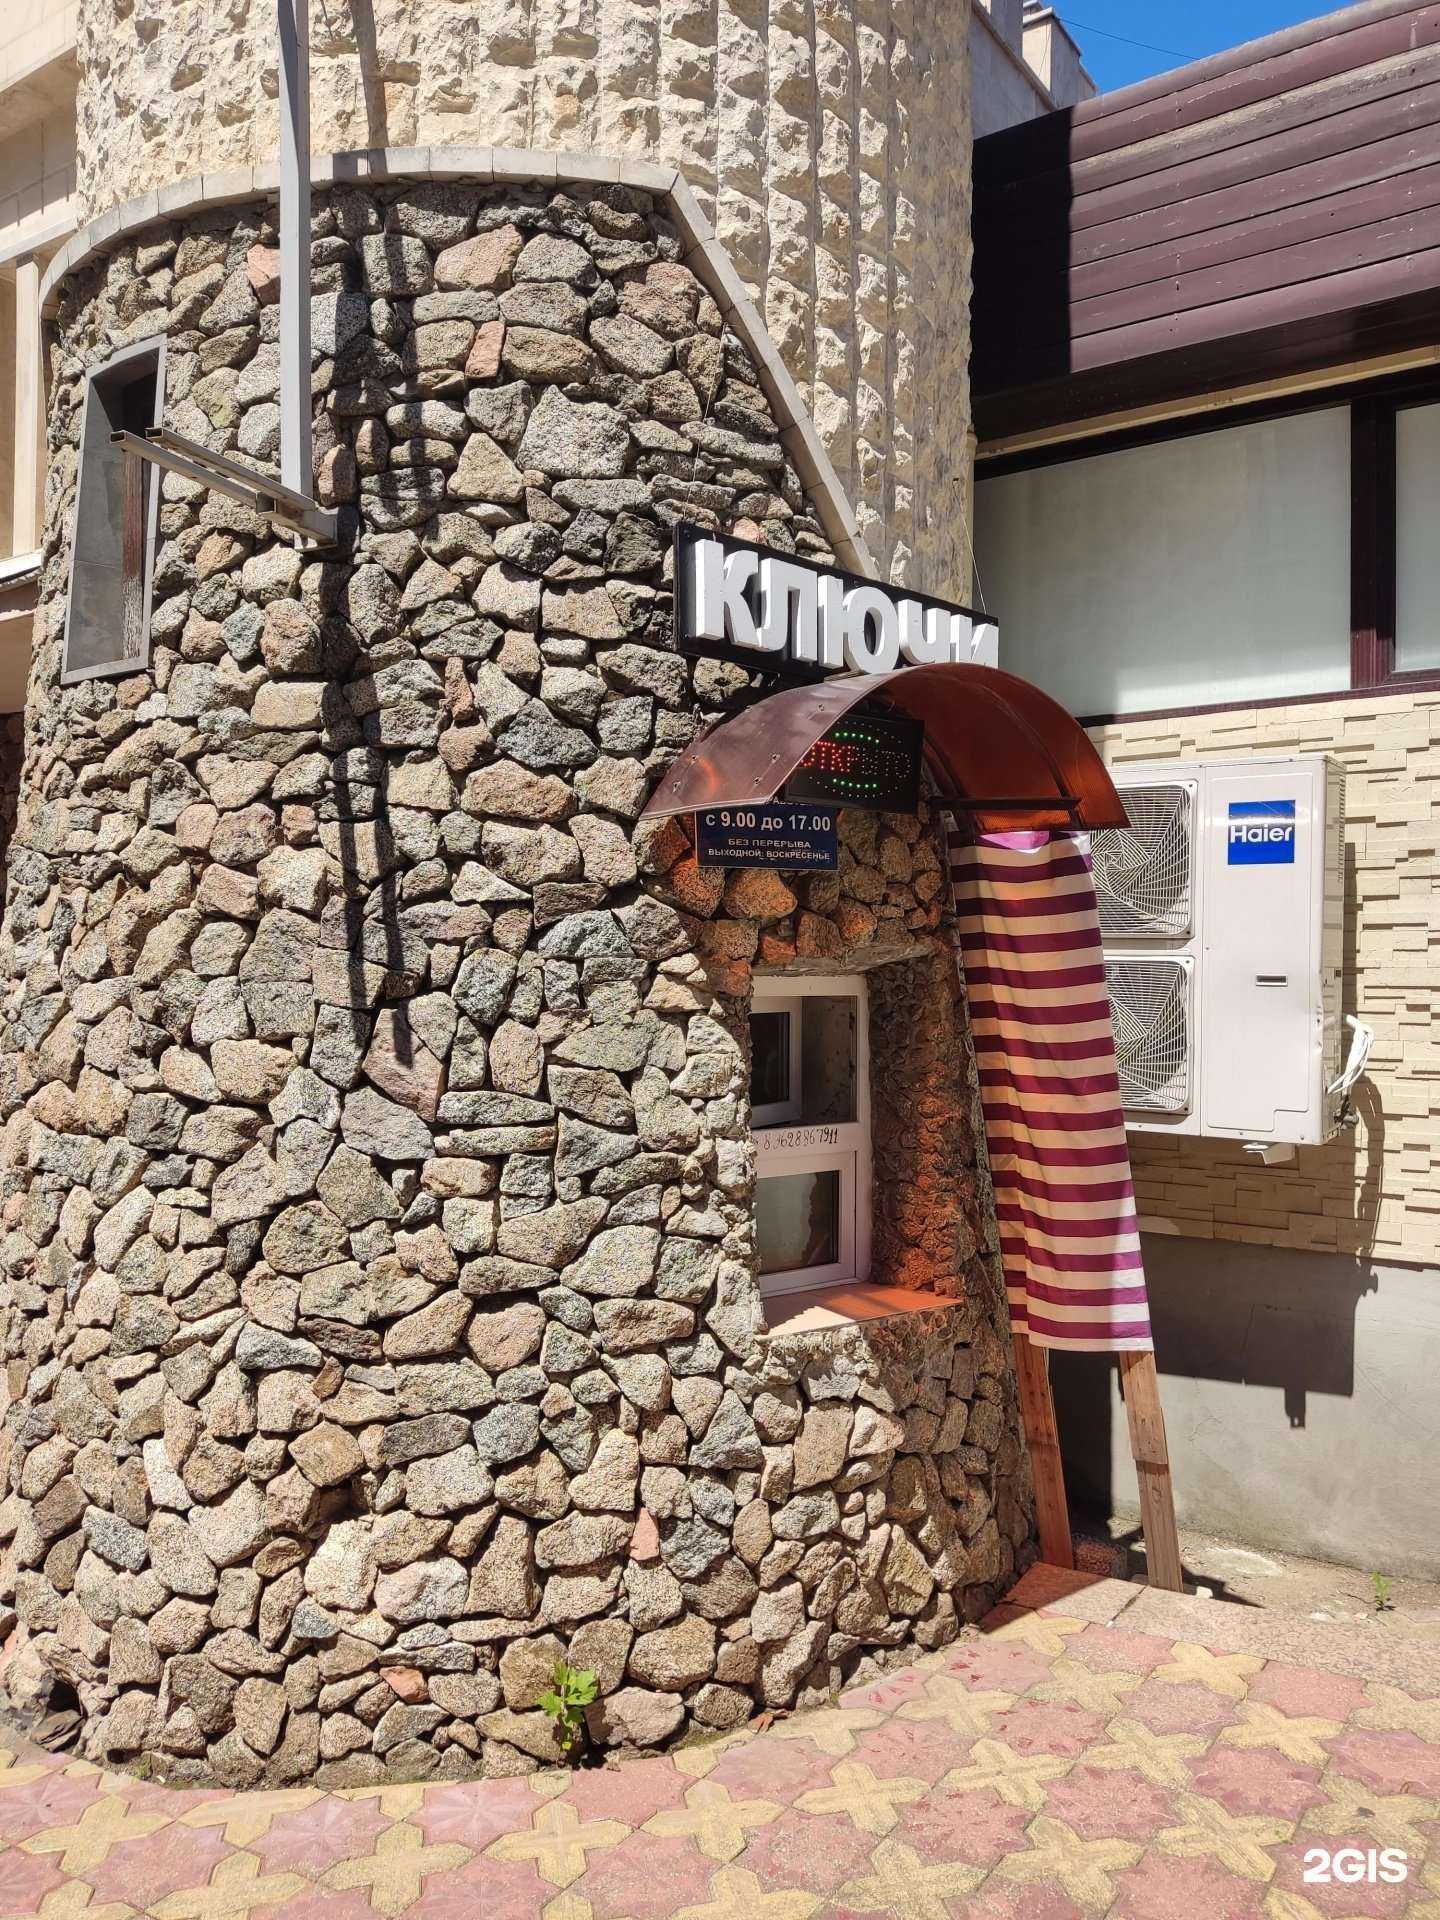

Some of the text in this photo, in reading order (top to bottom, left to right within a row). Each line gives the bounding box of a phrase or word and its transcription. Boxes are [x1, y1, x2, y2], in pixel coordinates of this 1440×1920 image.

[695, 538, 999, 674] КЛЮЧИ
[720, 811, 756, 828] 9.00
[760, 817, 783, 831] до
[788, 814, 831, 831] 17.00
[1230, 824, 1292, 843] Haier
[728, 838, 811, 849] БЕЗ ПЕРЕРЫВА
[766, 850, 830, 860] ВОСКРЕСЕНЬЕ
